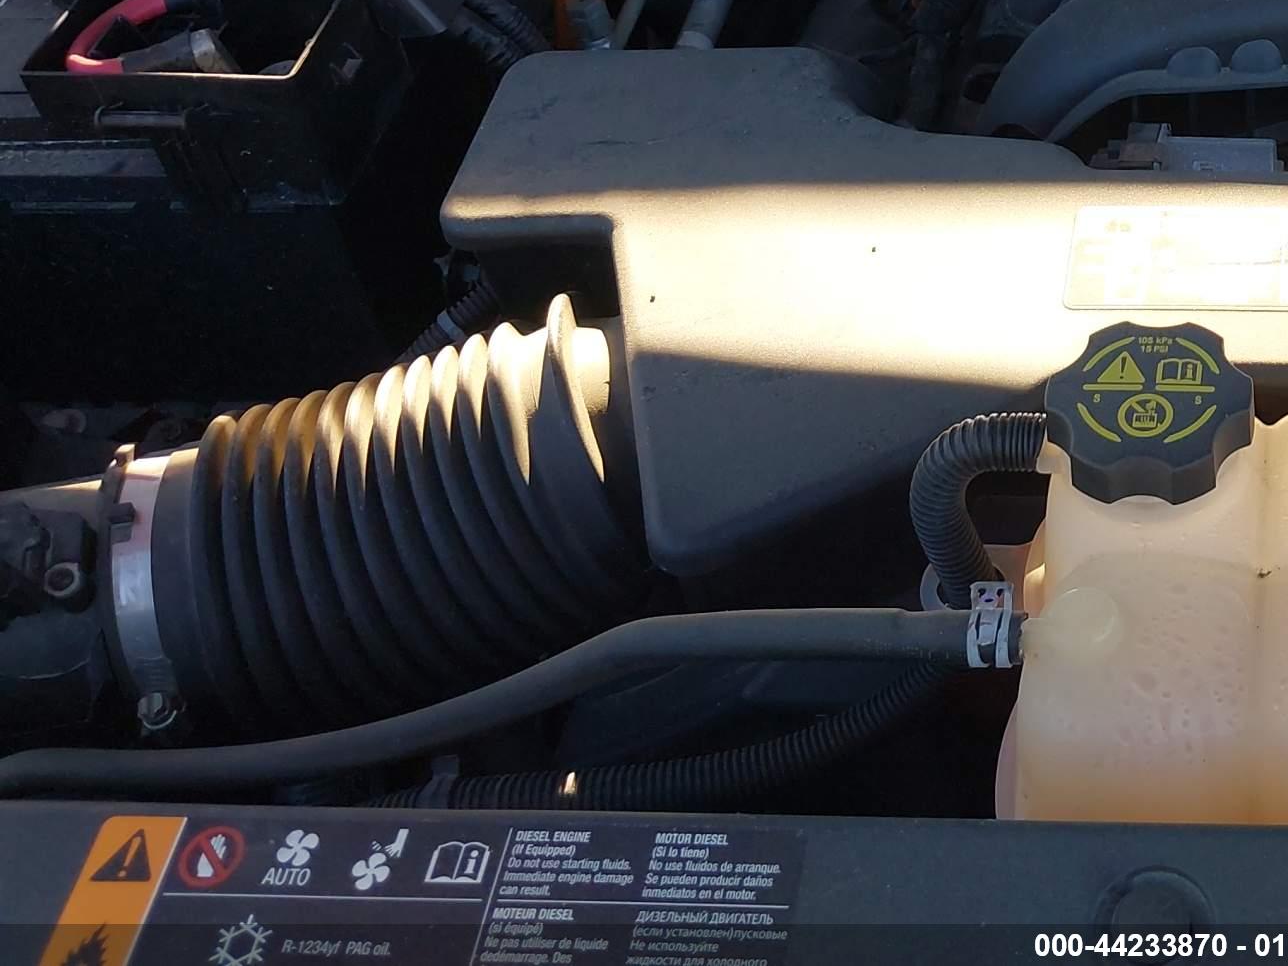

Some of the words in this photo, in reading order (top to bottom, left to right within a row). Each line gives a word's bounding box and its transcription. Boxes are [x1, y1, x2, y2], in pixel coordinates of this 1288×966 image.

[515, 830, 550, 842] DIESEL
[553, 831, 591, 843] ENGINE
[655, 833, 691, 844] MOTOR
[693, 834, 729, 845] DIESEL
[525, 844, 576, 857] Equipped)
[652, 846, 666, 858] (Si
[668, 846, 678, 858] lo
[680, 847, 710, 860] tiene)
[507, 858, 521, 868] Do
[523, 858, 539, 868] not
[542, 860, 560, 869] use
[562, 859, 600, 871] starting
[602, 859, 632, 870] fluids.
[648, 860, 663, 871] No
[664, 861, 683, 871] use
[685, 860, 718, 872] fluidos
[720, 861, 733, 873] de
[735, 863, 781, 875] arranque.
[261, 867, 311, 886] AUTO
[503, 871, 556, 882] Immediate
[558, 873, 592, 884] engine
[593, 872, 634, 885] damage
[645, 873, 658, 884] Se
[660, 874, 697, 886] pueden
[699, 875, 741, 887] producir
[743, 875, 774, 887] daños
[499, 886, 518, 895] can
[519, 885, 551, 896] result.
[641, 886, 697, 898] inmediatos
[698, 889, 711, 899] en
[713, 888, 724, 899] el
[725, 889, 757, 900] motor.
[492, 907, 537, 920] MOTEUR
[538, 908, 575, 921] DIESEL
[635, 909, 708, 923] ДИЗЕЛЬНЫЙ
[709, 912, 774, 925] ДВИГАТЕЛЬ
[488, 922, 501, 934] (si
[503, 921, 544, 935] équipé)
[281, 939, 341, 957] R-1234yf
[345, 940, 373, 956] PAG
[373, 942, 391, 956] oil.
[484, 936, 498, 948] Ne
[500, 938, 519, 950] pas
[521, 937, 556, 949] utiliser
[558, 938, 572, 950] de
[574, 938, 609, 952] liquide
[629, 940, 645, 951] Не
[552, 951, 573, 964] Des
